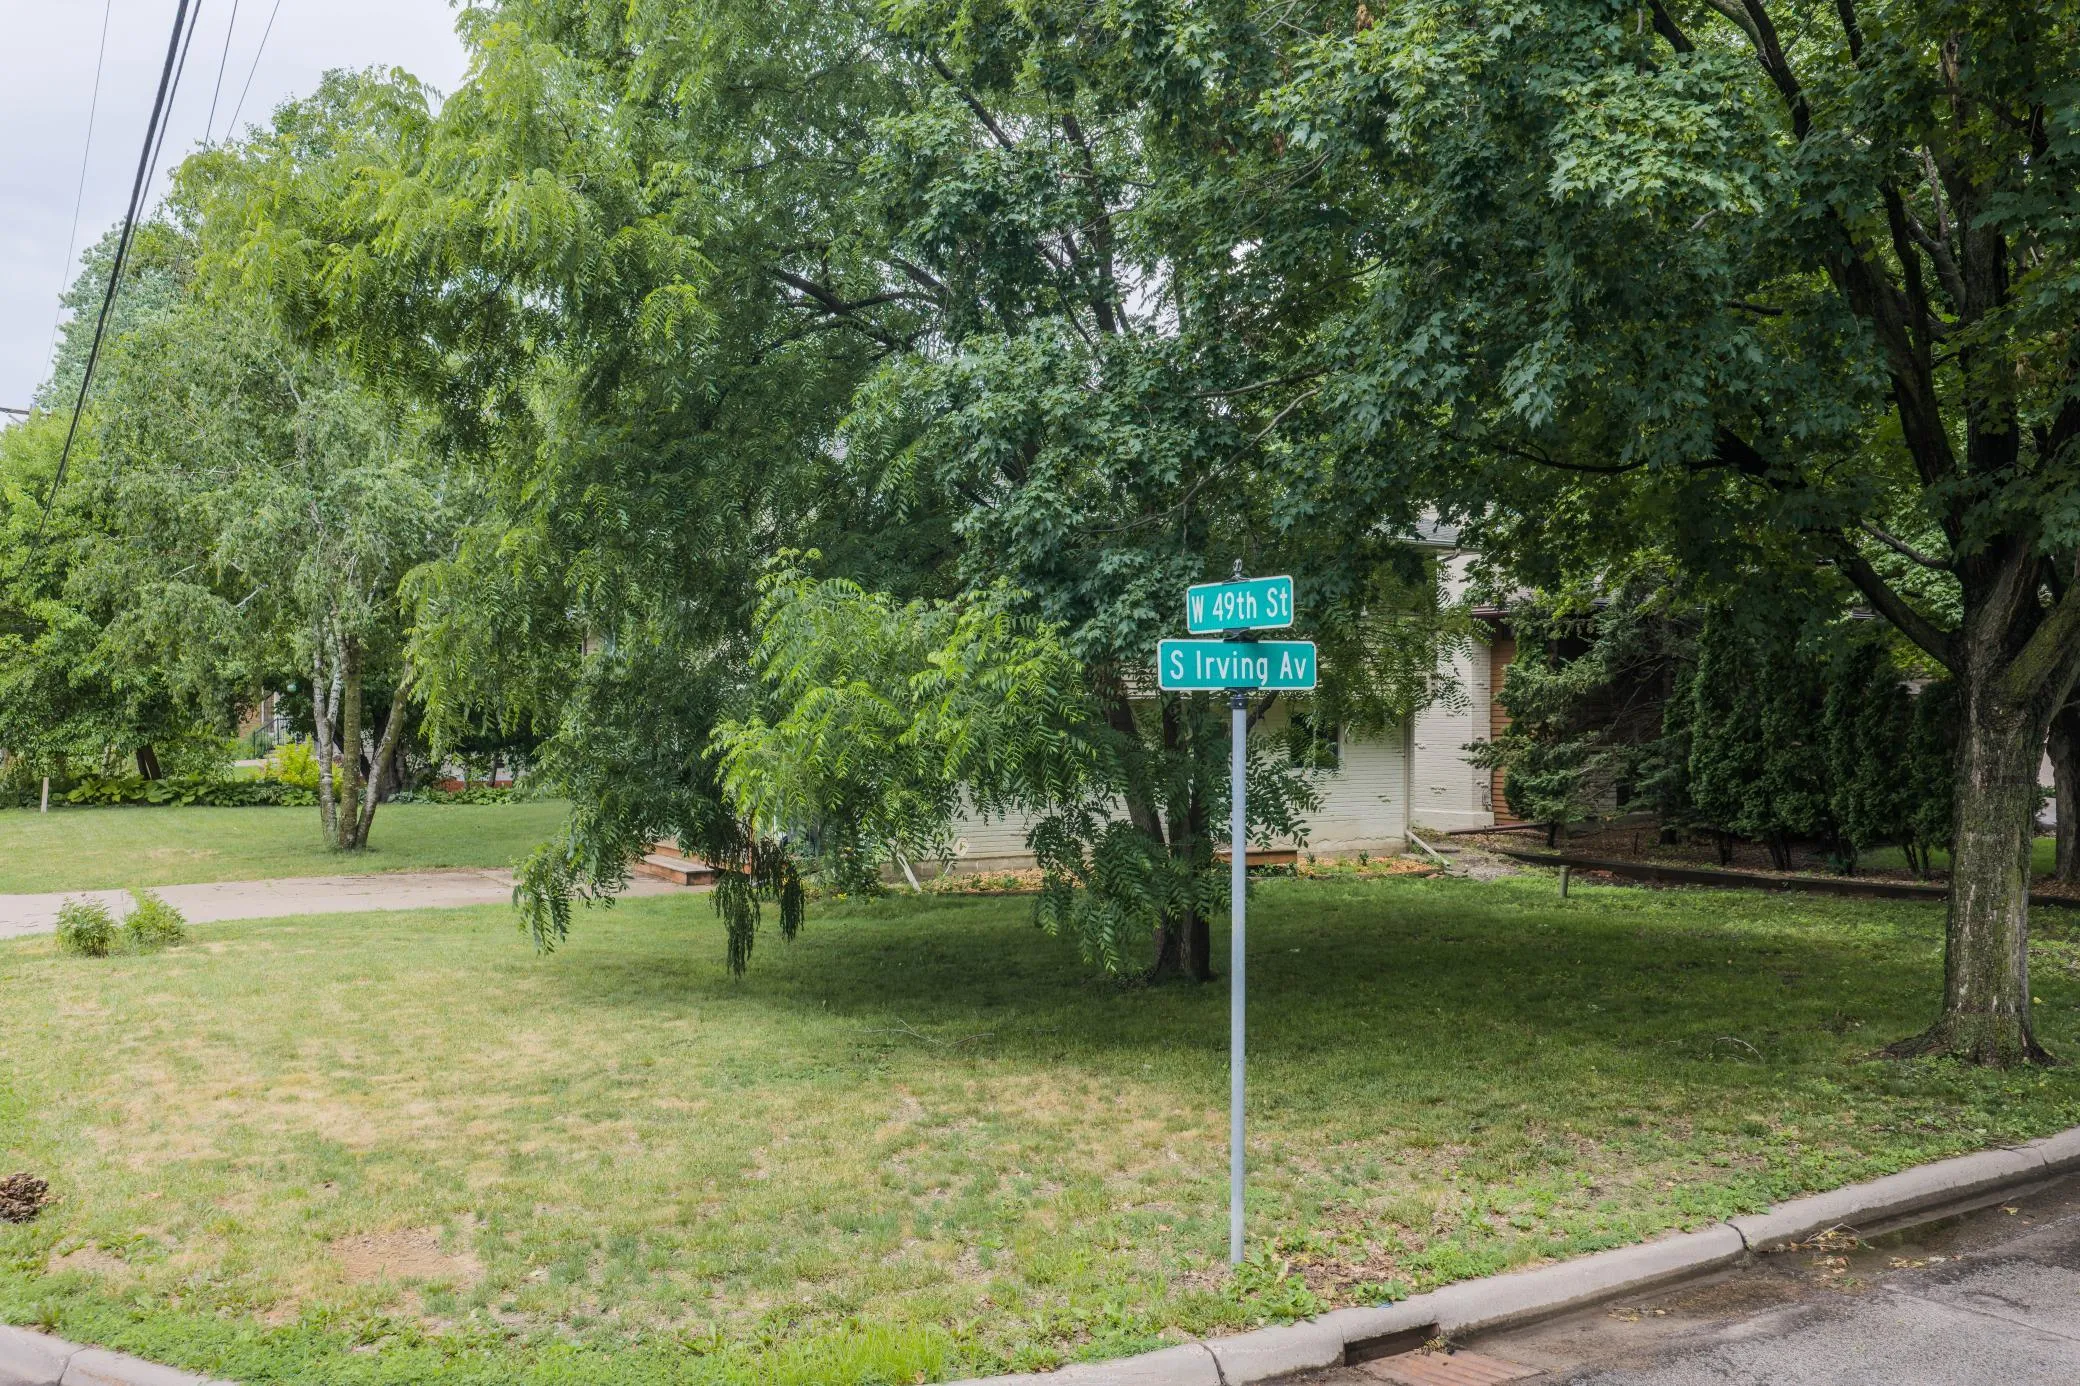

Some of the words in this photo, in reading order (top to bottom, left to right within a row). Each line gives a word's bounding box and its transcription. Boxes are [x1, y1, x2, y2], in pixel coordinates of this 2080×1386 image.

[1191, 594, 1204, 624] W
[1212, 591, 1257, 622] 49th
[1266, 587, 1288, 618] St
[1170, 650, 1184, 680] S
[1196, 650, 1268, 686] Irving
[1279, 651, 1306, 680] Av
